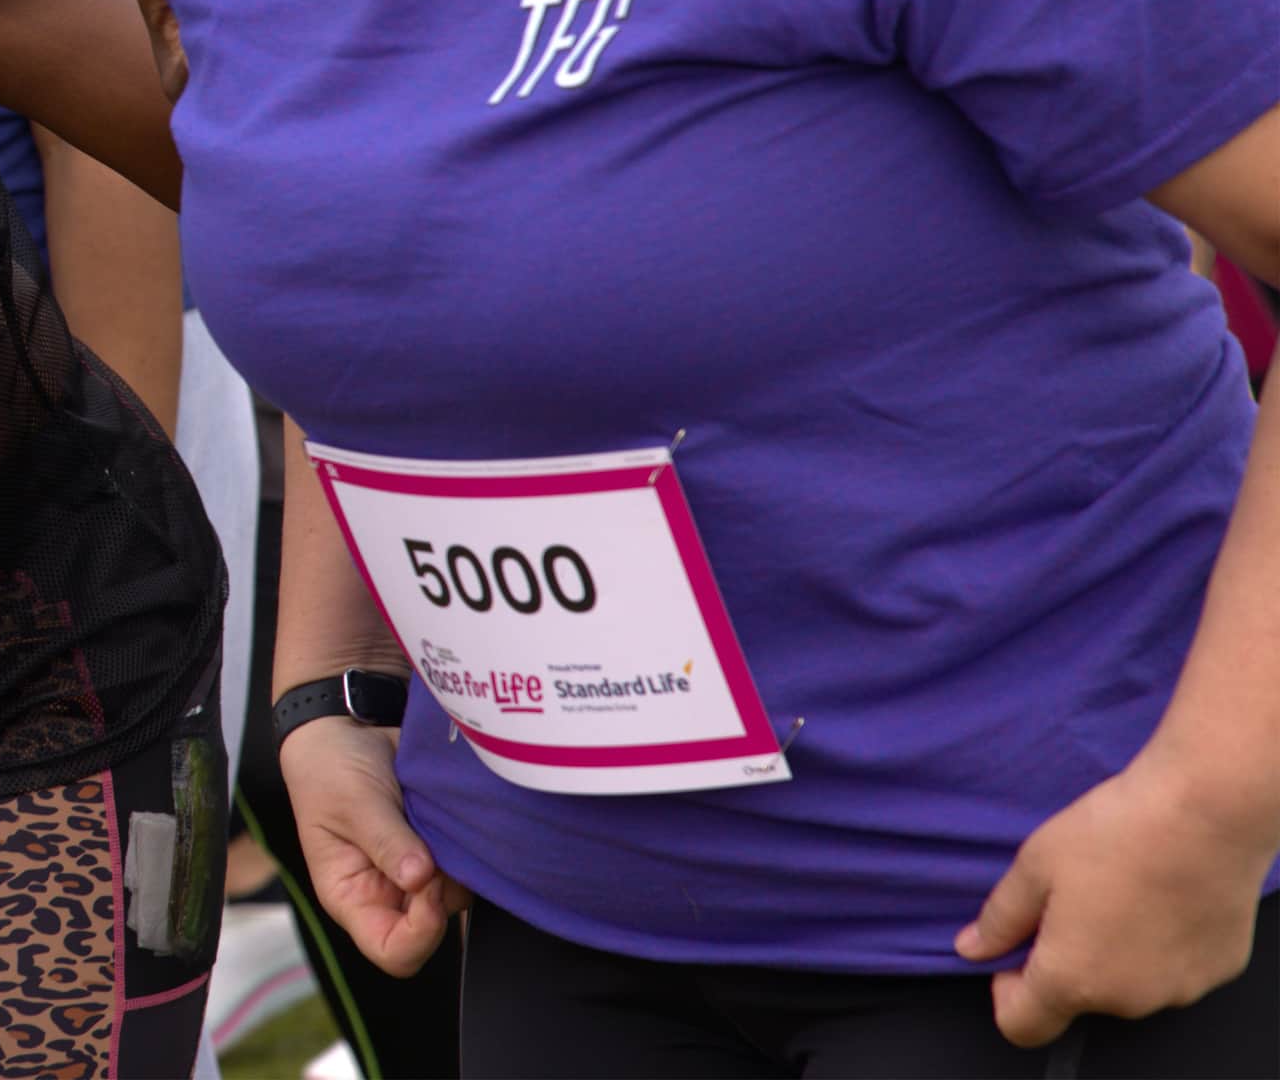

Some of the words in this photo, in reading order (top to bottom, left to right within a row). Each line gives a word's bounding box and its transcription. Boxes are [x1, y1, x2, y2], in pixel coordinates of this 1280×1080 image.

[403, 537, 597, 614] 5000
[463, 670, 490, 699] for
[490, 670, 543, 704] Life
[554, 675, 647, 699] Standard
[646, 671, 690, 696] Life
